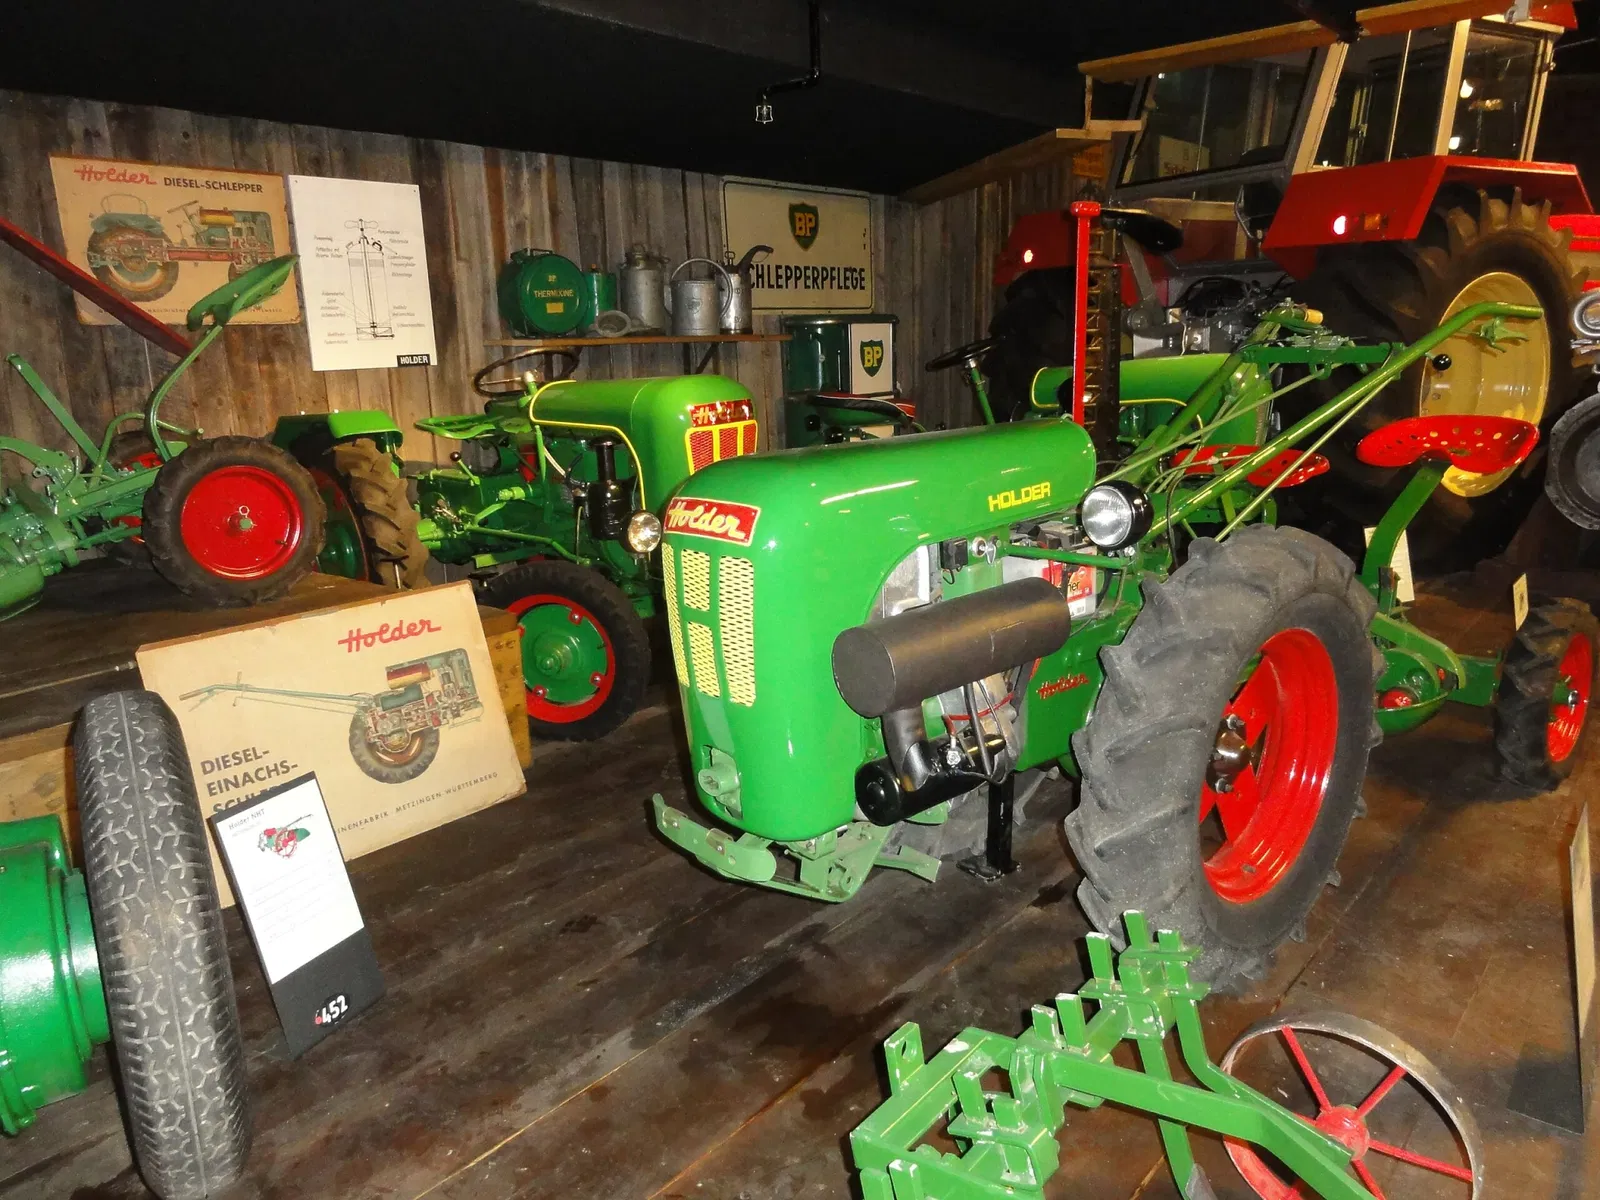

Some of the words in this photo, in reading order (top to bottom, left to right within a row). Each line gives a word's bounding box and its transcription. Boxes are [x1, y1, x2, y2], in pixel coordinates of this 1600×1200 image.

[74, 165, 157, 186] Holder
[163, 176, 263, 193] DIESEL-SCHLEPPER
[794, 212, 816, 237] BP
[750, 263, 865, 290] CHLEPPERPFLEGE
[400, 355, 429, 365] HOLDER
[863, 346, 882, 367] BP
[988, 481, 1051, 512] HOLDER
[667, 501, 746, 540] Holder
[338, 619, 442, 653] Holder
[1036, 673, 1090, 700] Holder
[200, 746, 270, 775] DIESEL-
[206, 760, 299, 797] EINACHS-
[337, 811, 389, 834] INENFABRIK
